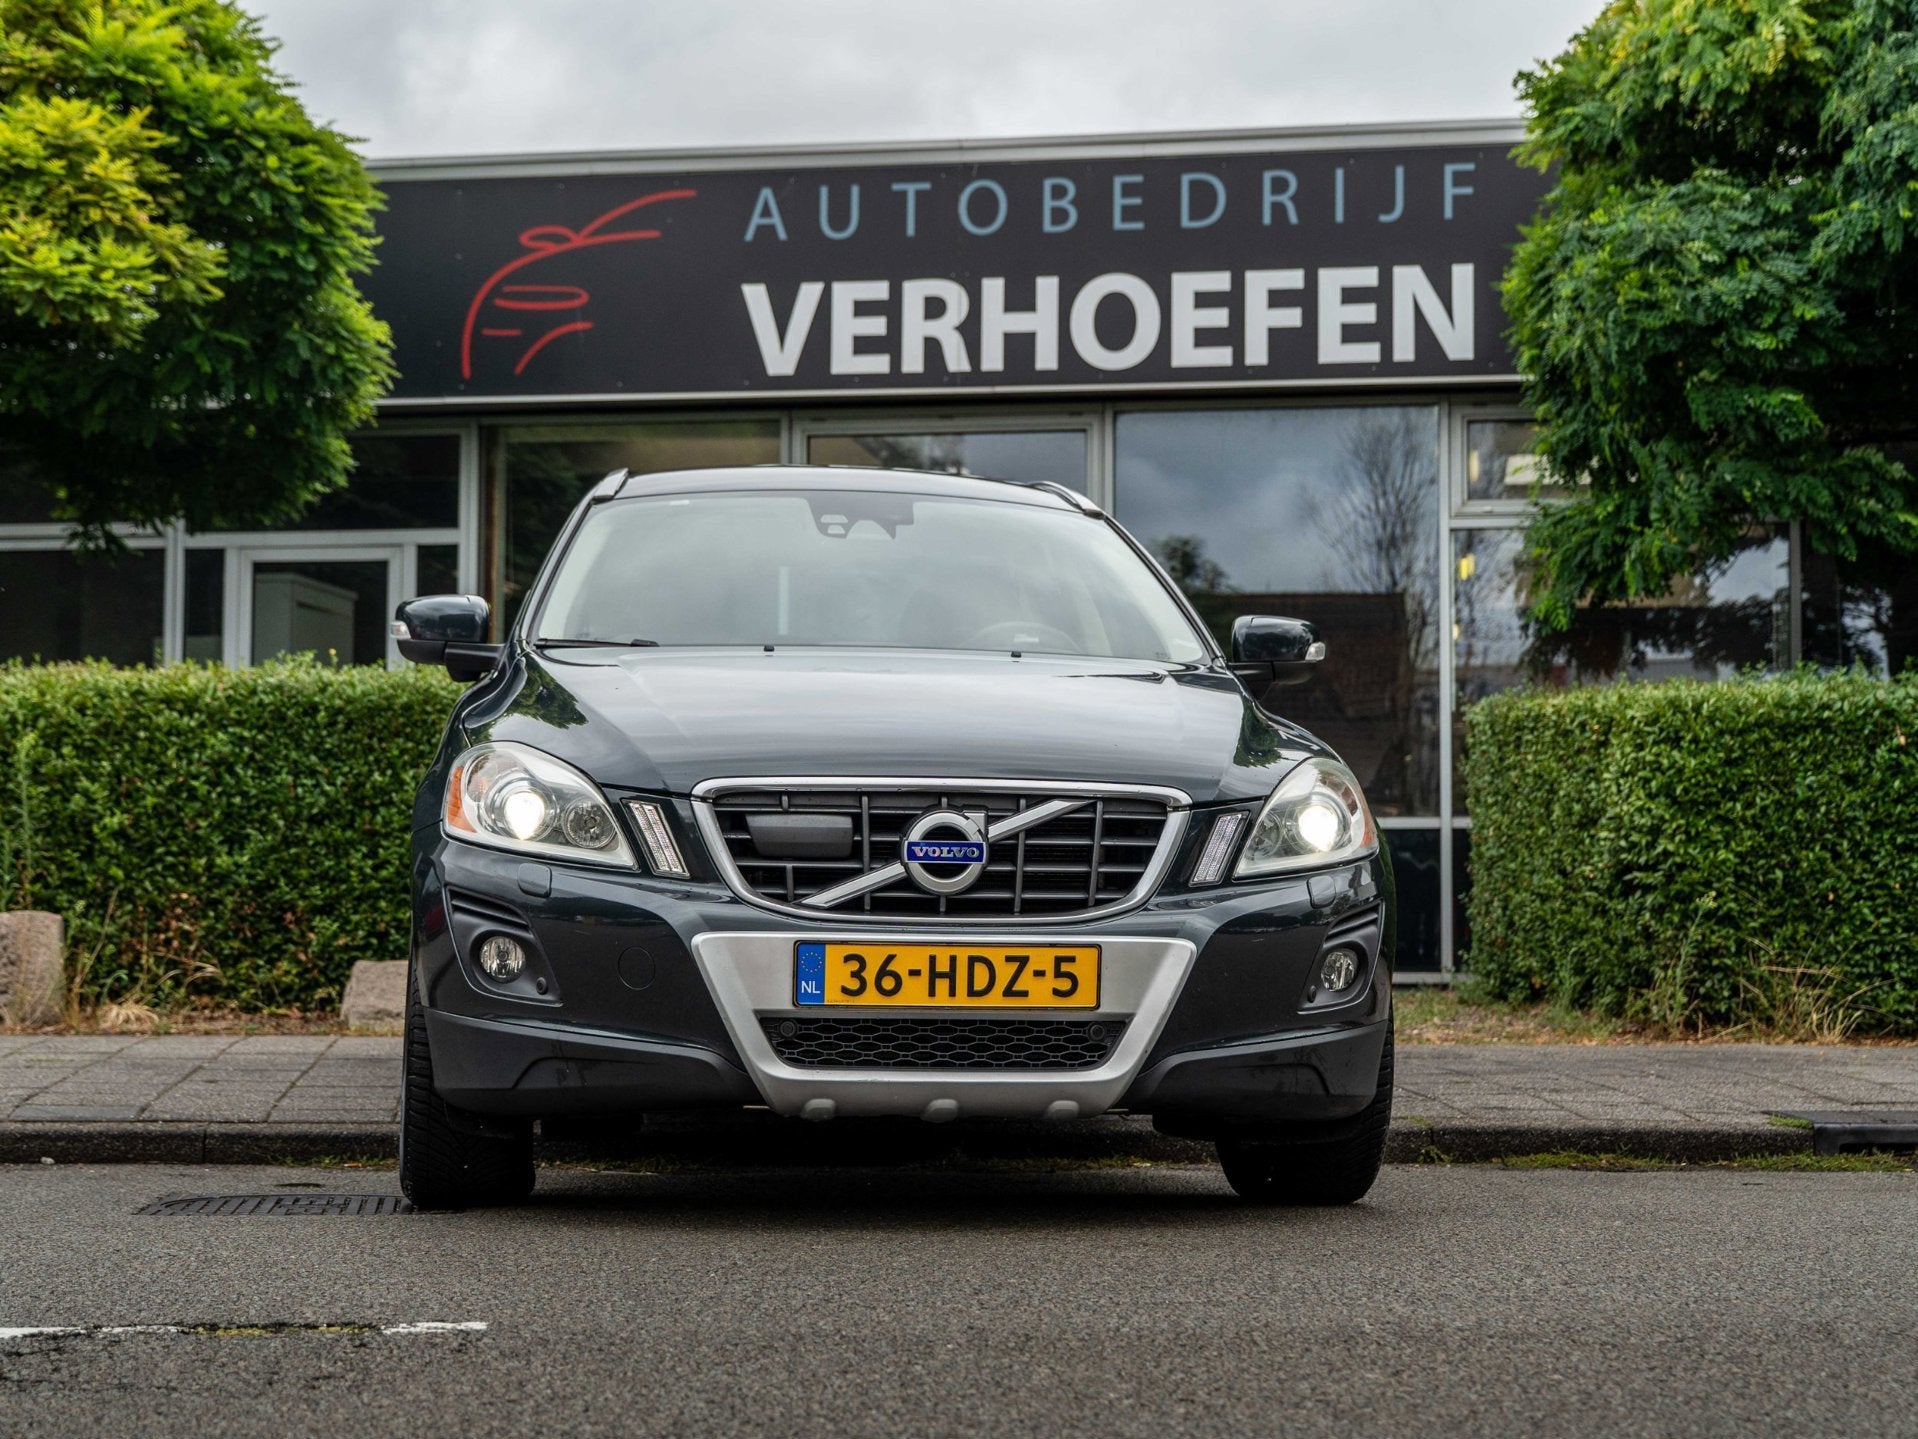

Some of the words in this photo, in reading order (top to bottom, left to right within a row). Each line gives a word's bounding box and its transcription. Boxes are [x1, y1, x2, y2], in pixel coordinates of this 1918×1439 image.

[743, 162, 1478, 243] AUTOBEDRIJF
[740, 262, 1476, 378] VERHOEFEN
[911, 846, 980, 858] VOLVO
[801, 980, 821, 994] NL
[840, 953, 1080, 998] 36-HDZ-5
